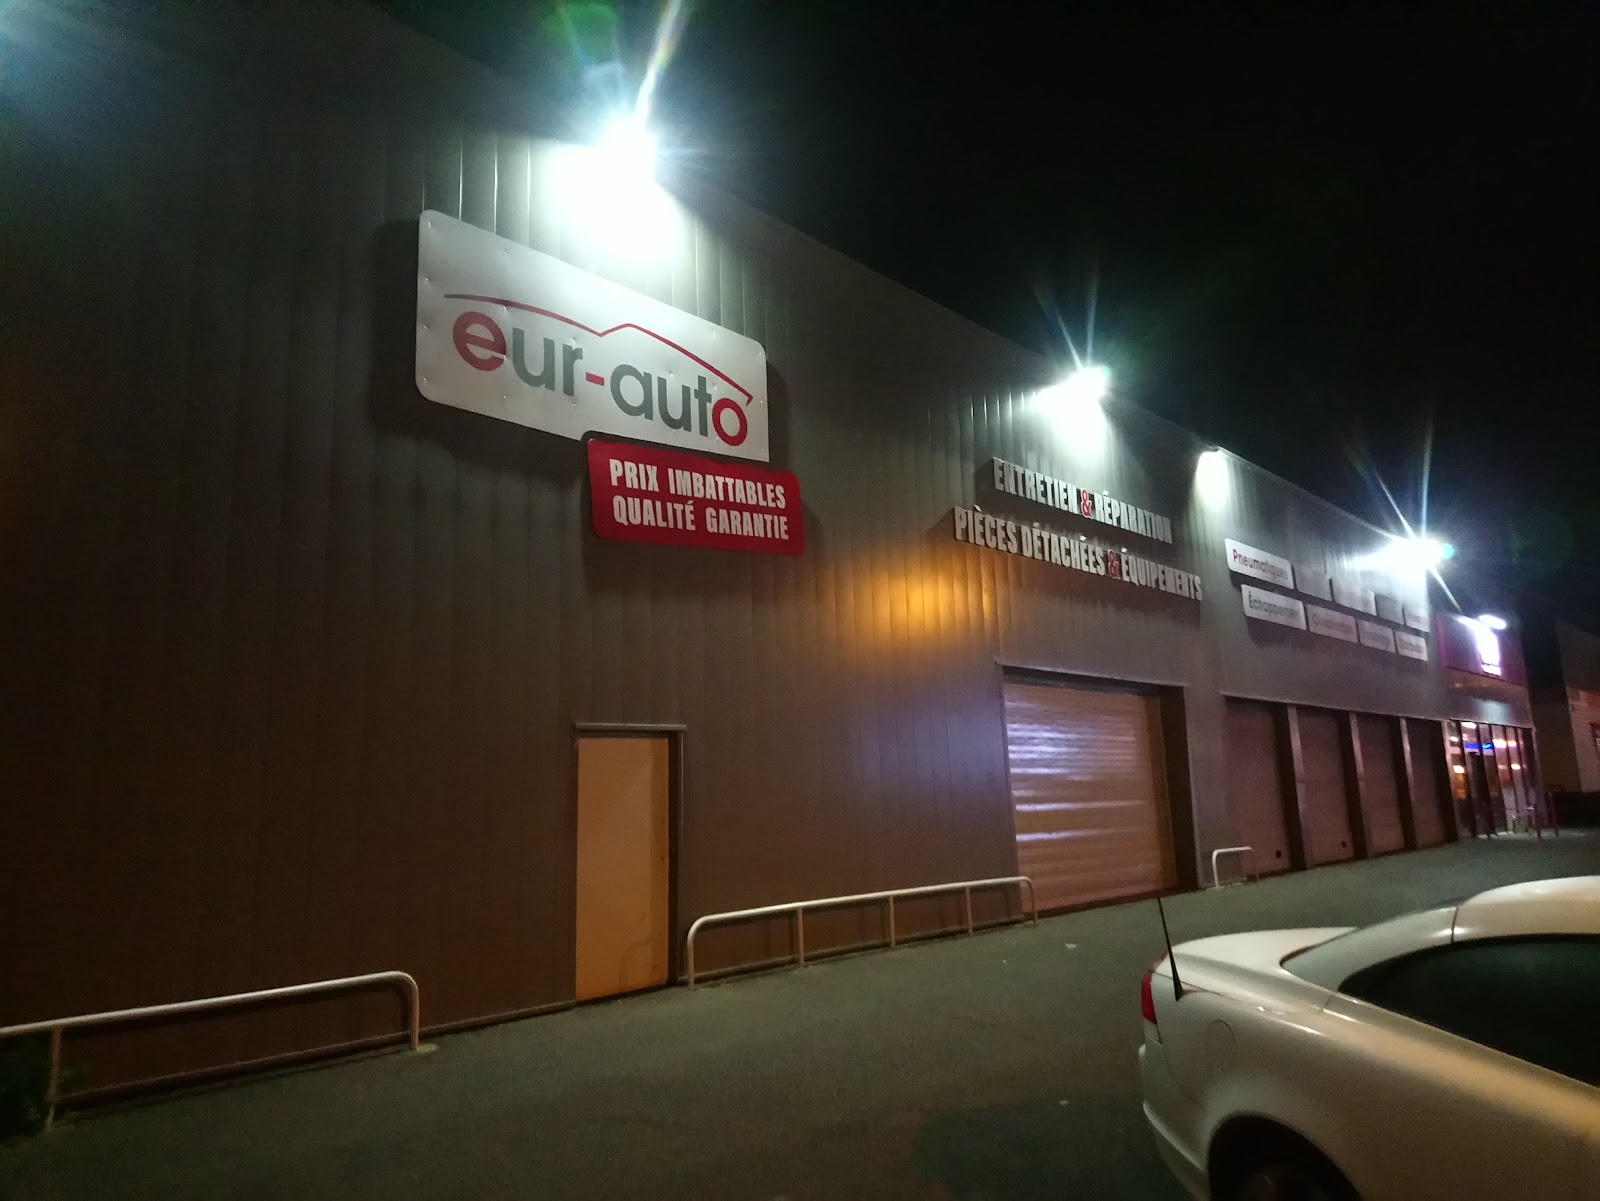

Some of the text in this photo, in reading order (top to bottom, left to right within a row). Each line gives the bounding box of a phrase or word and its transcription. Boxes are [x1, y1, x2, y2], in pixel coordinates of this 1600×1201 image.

[452, 311, 748, 446] eur-auto
[609, 458, 786, 510] PRIX IMBATTABLES
[612, 495, 789, 540] QUALITÉ GARANTIE
[993, 457, 1173, 544] ENTRETIEN & RÉPARATION
[953, 504, 1202, 601] PIÈCES DÉTACHÉES & ÉQUIPEMENTS
